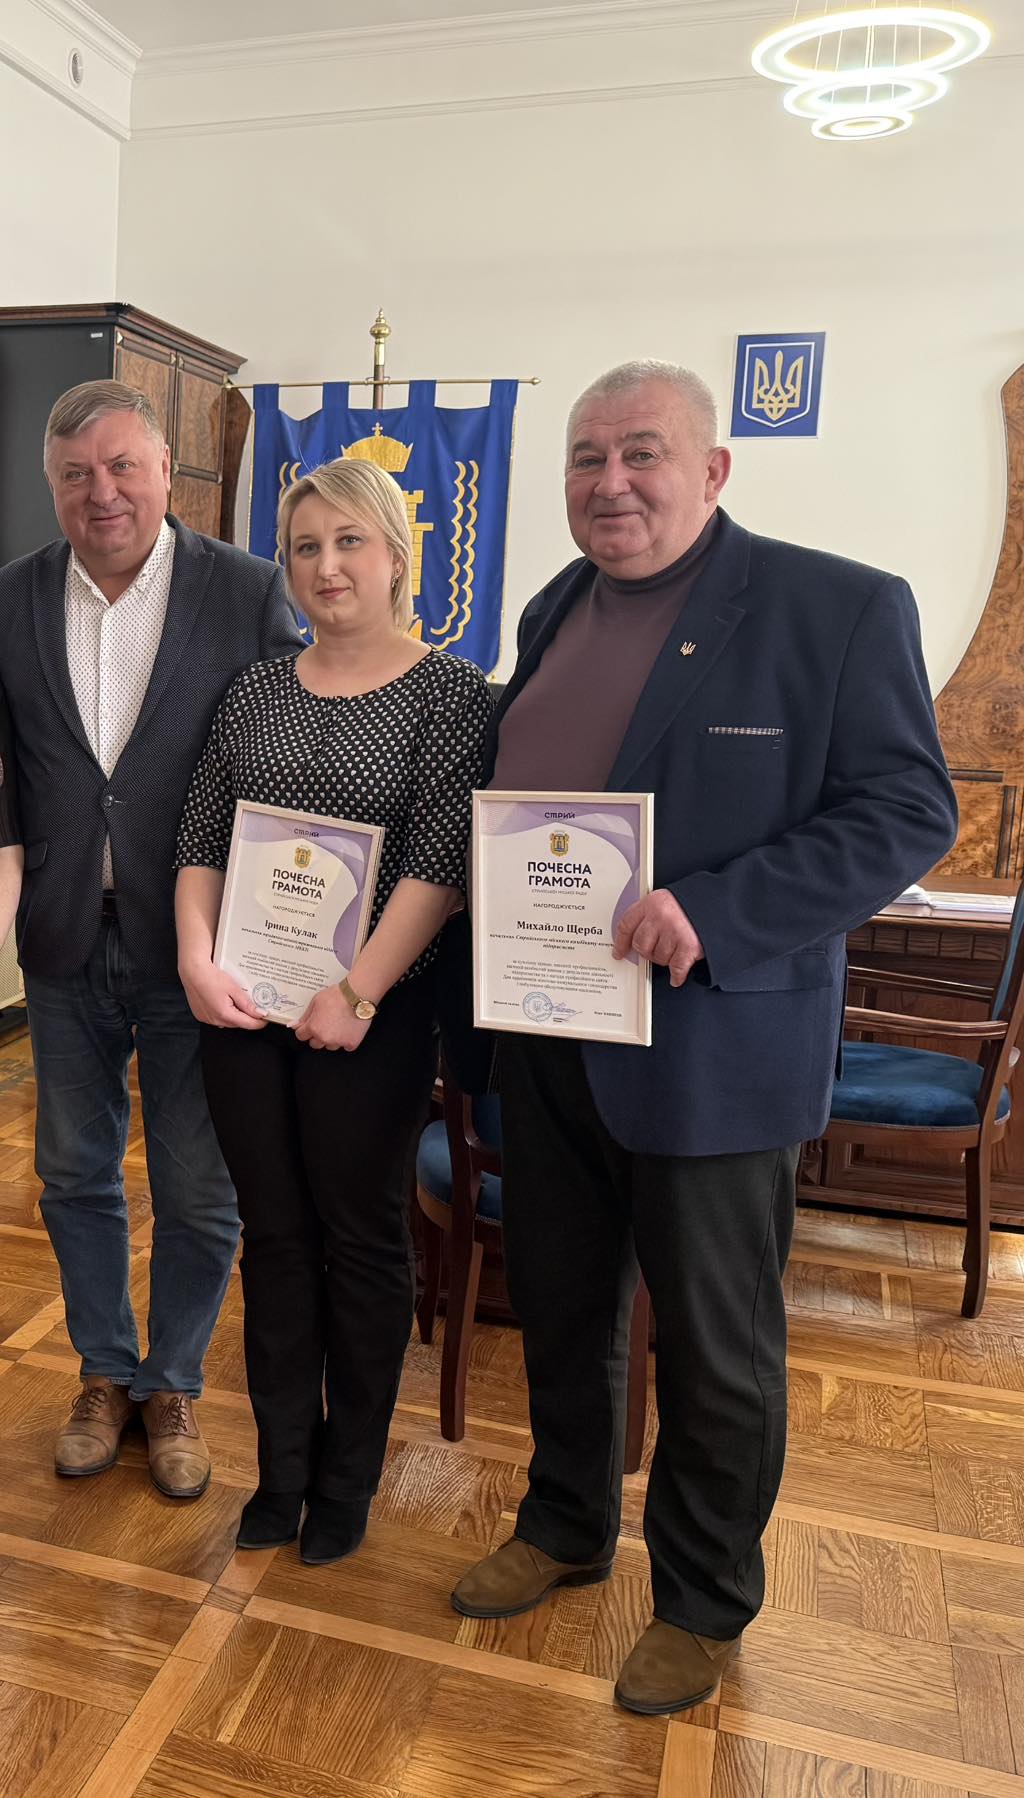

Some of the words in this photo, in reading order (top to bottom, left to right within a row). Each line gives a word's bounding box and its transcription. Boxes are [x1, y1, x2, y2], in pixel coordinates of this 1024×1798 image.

[527, 861, 593, 875] ПОЧЕСНА
[272, 868, 326, 889] ПОЧЕСНА
[528, 875, 591, 888] ГРАМОТА
[271, 880, 323, 900] ГРАМОТА
[533, 903, 586, 911] НАГОРОДЖУЄТЬСЯ
[264, 919, 289, 933] Ірина
[290, 925, 318, 940] Кулак
[516, 920, 564, 932] Михайло
[566, 924, 603, 936] Щерба
